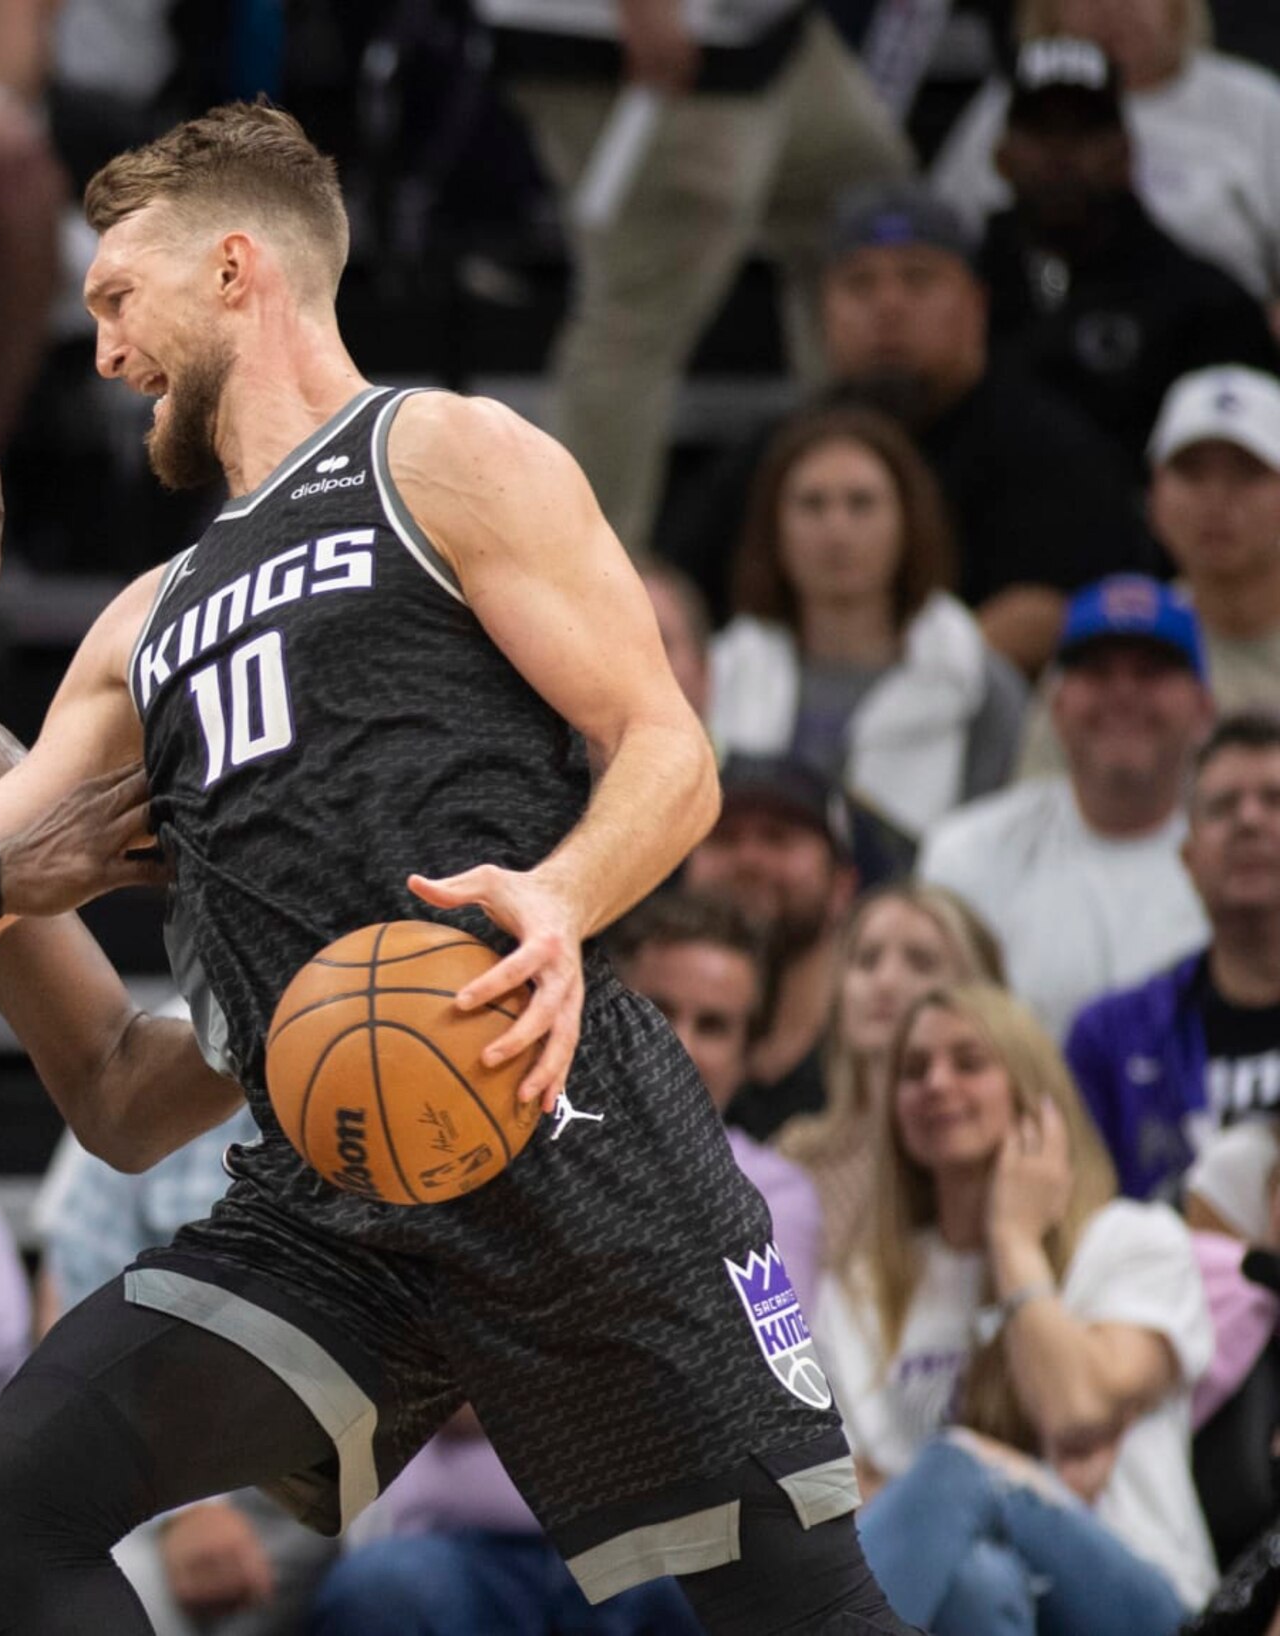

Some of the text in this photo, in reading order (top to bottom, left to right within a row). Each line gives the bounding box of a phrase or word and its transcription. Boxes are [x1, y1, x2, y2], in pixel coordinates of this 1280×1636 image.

[290, 469, 367, 500] dialpad
[138, 528, 376, 710] KINGS
[188, 629, 293, 788] 10
